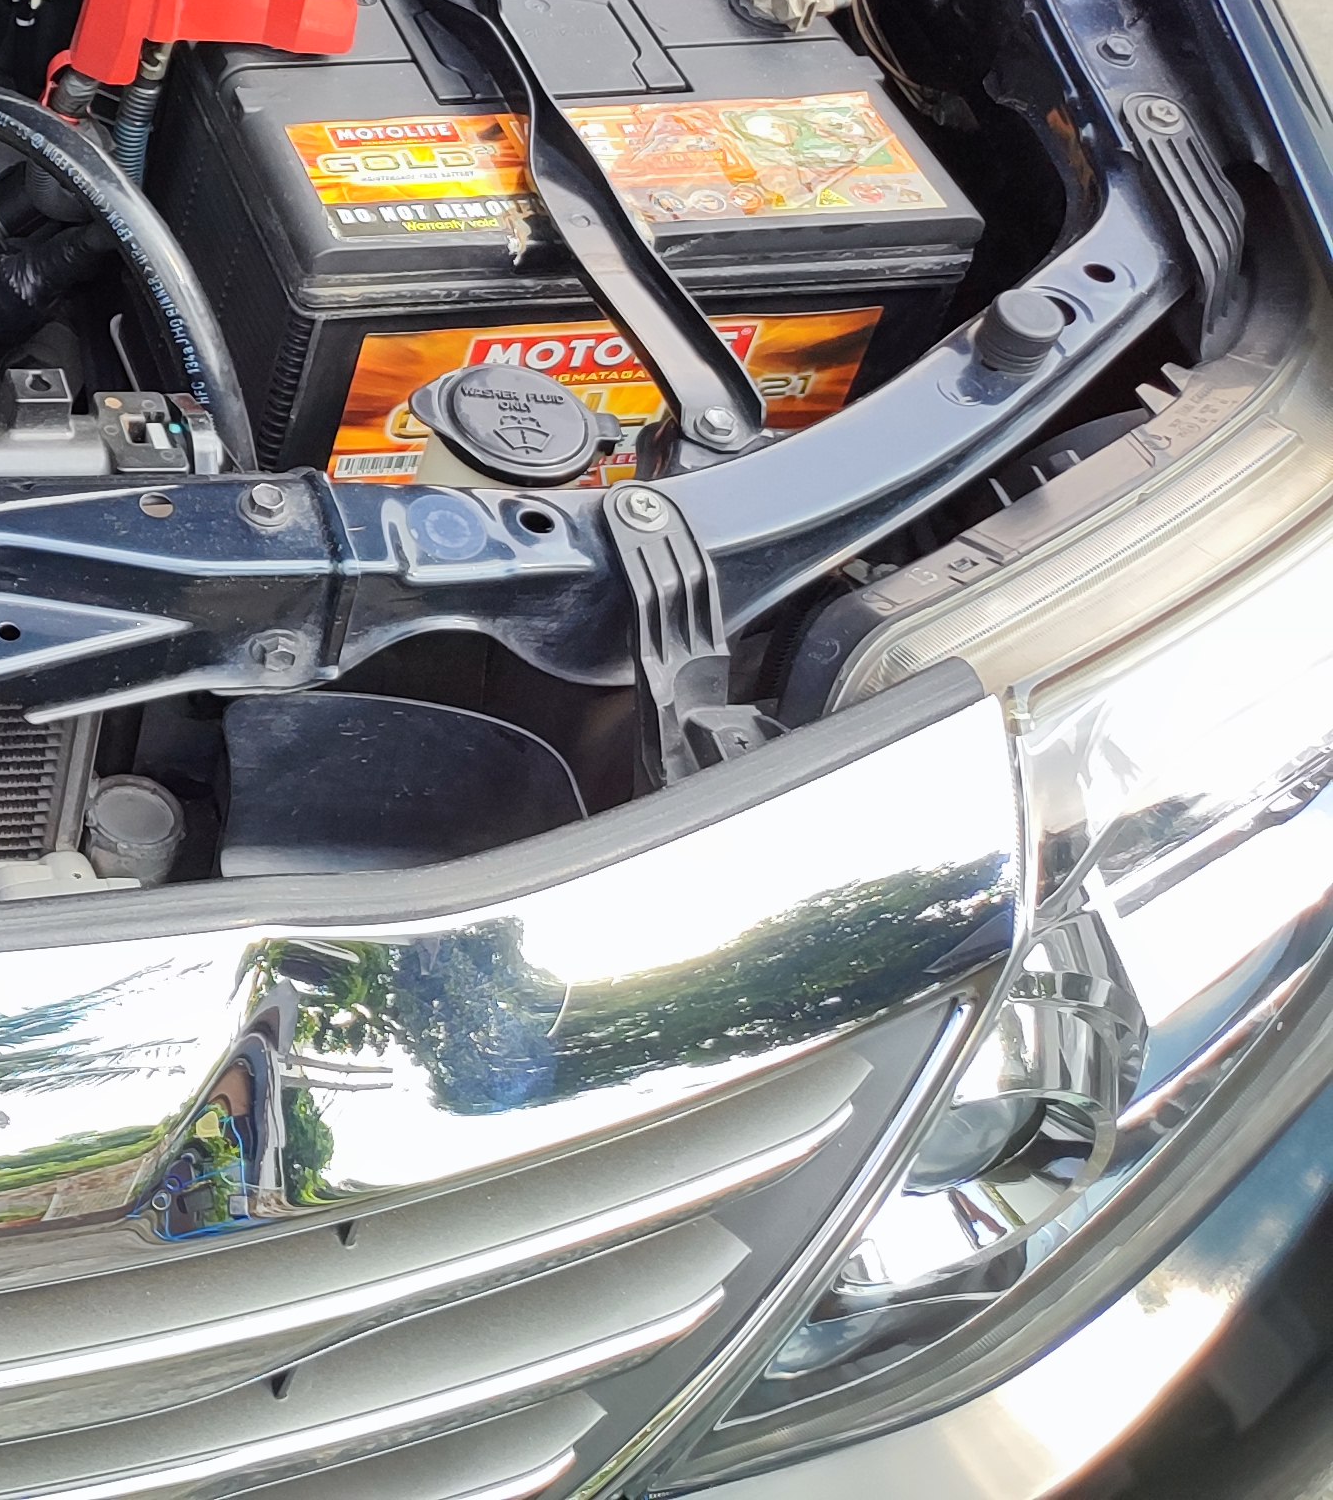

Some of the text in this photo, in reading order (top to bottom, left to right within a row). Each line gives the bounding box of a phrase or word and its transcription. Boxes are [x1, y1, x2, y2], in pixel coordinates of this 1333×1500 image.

[335, 124, 453, 141] MOTOLITE
[318, 148, 476, 174] GOLD
[336, 206, 371, 225] DO
[378, 204, 428, 224] NOT
[402, 216, 500, 232] Warranty void
[191, 381, 210, 405] HFC
[461, 385, 565, 405] WASHER FLUID
[498, 401, 531, 413] ONLY
